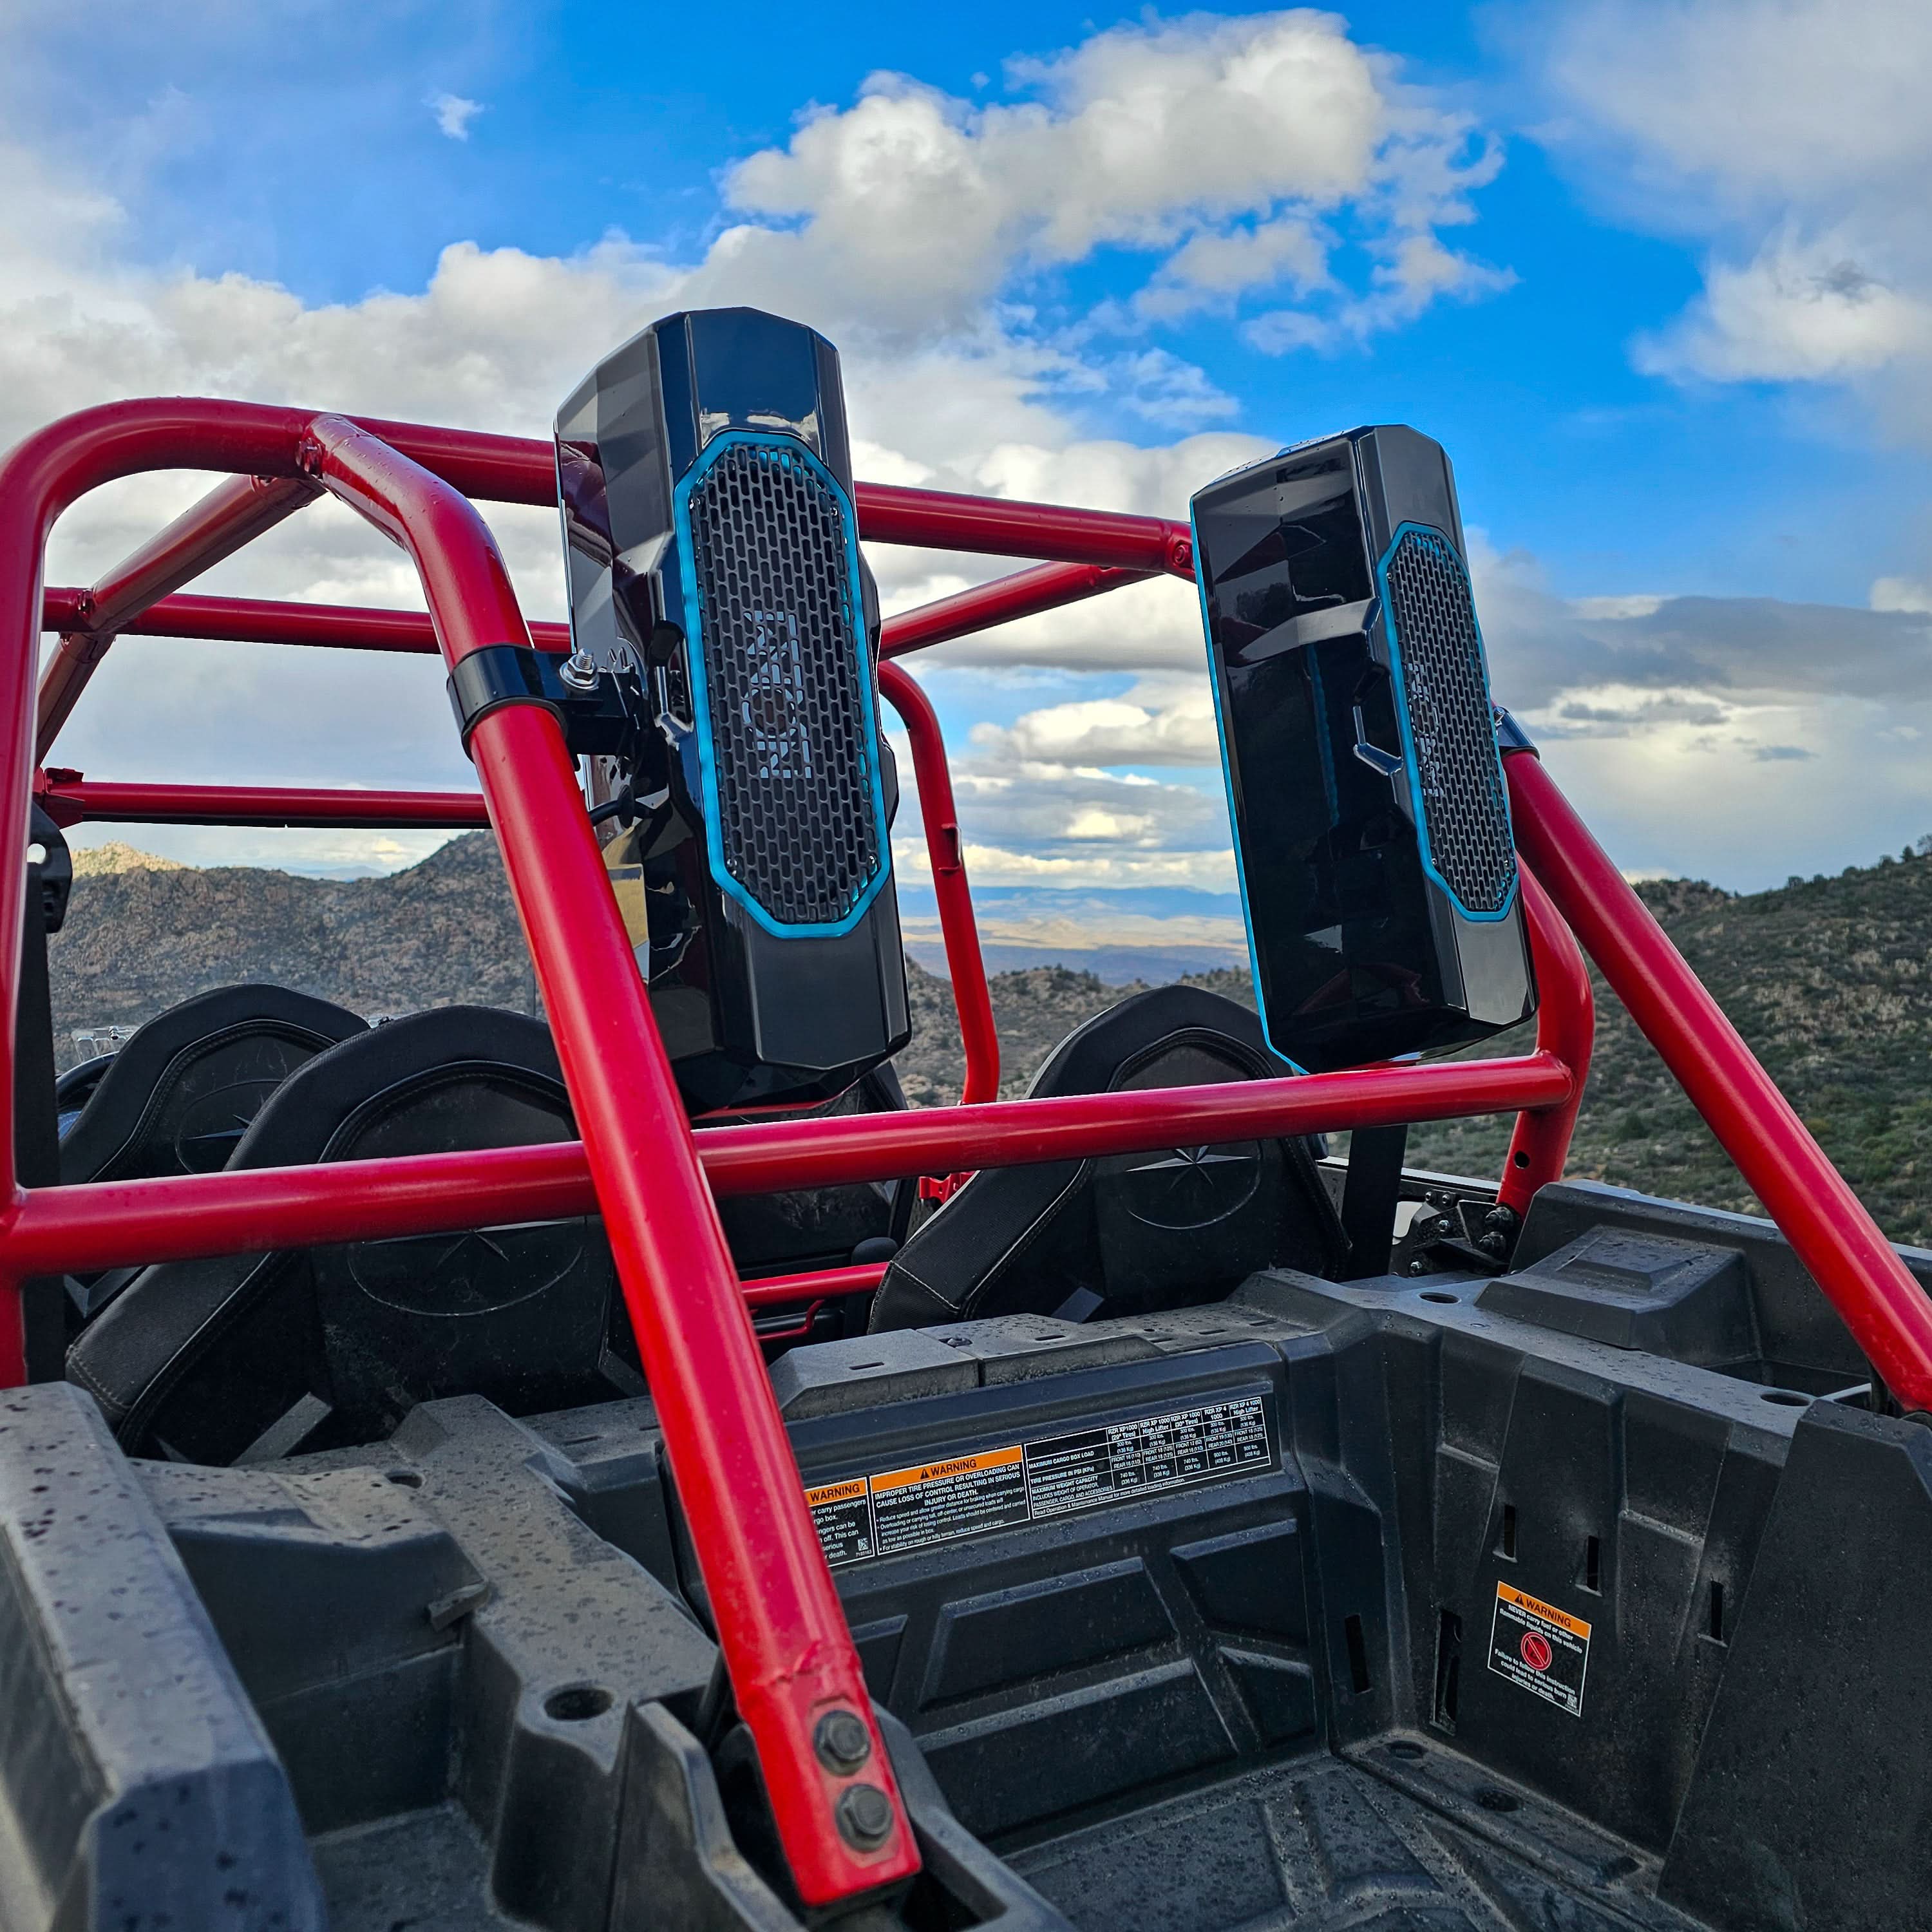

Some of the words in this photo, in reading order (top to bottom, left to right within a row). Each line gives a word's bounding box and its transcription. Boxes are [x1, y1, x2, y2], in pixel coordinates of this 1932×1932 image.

[931, 1459, 976, 1475] WARNING
[1029, 1460, 1052, 1468] MAXIMUM
[875, 1488, 907, 1499] IMPROPER
[923, 1477, 954, 1489] PRESSURE
[965, 1467, 1006, 1480] OVERLOADING
[1032, 1485, 1055, 1494] MAXIMUM
[1075, 1475, 1097, 1484] CAPACITY
[1043, 1472, 1067, 1481] PRESSURE
[811, 1484, 859, 1501] WARNING
[876, 1498, 897, 1508] CAUSE
[898, 1494, 914, 1503] LOSS
[925, 1486, 953, 1497] CONTROL
[955, 1479, 987, 1490] RESULTING
[996, 1472, 1020, 1482] SERIOUS
[925, 1496, 946, 1506] INJURY
[958, 1489, 978, 1499] DEATH.
[834, 1499, 866, 1511] passengers
[880, 1520, 905, 1530] Overloading
[829, 1550, 847, 1558] death.
[1527, 1600, 1570, 1627] WARNING
[1500, 1608, 1525, 1625] flammable
[1526, 1622, 1543, 1634] liquids
[1552, 1634, 1562, 1643] this
[1509, 1605, 1526, 1617] NEVER
[1527, 1615, 1540, 1625] carry
[1541, 1621, 1551, 1630] fuel
[1558, 1631, 1573, 1640] other
[1495, 1649, 1512, 1662] Failure
[1520, 1662, 1535, 1673] follow
[1536, 1669, 1546, 1680] this
[1547, 1676, 1575, 1694] instruction
[1501, 1661, 1515, 1671] could
[1516, 1668, 1527, 1677] lead
[1535, 1678, 1553, 1691] serious
[1554, 1688, 1566, 1698] burn
[1511, 1674, 1530, 1687] injuries
